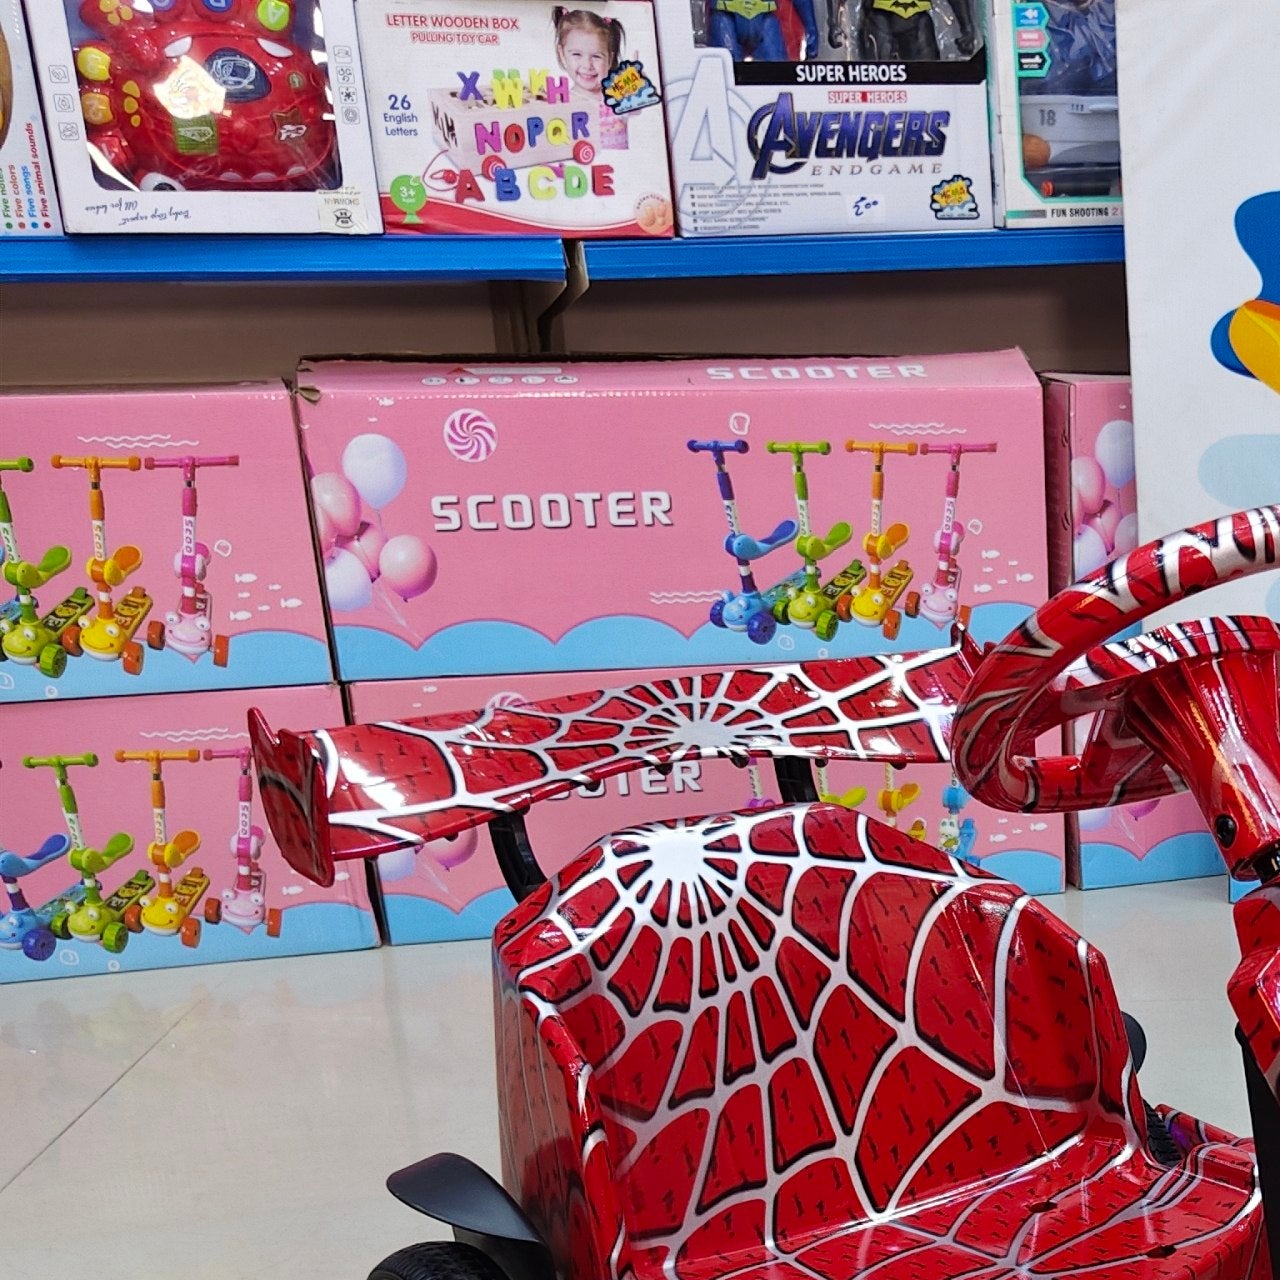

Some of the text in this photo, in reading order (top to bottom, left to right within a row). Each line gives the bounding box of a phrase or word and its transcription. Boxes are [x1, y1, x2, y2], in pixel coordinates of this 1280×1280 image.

[386, 14, 520, 30] LETTER WOODEN BOX
[411, 31, 498, 45] PULLING TOY CAR
[796, 65, 907, 83] SUPER HEROES
[387, 94, 412, 111] 26
[828, 91, 907, 104] SUPER HEROES
[383, 112, 418, 125] English
[1039, 109, 1056, 126] 18
[385, 126, 418, 137] Letters
[747, 92, 951, 181] AVENGERS
[24, 122, 49, 218] Five animal sounds
[811, 163, 943, 177] ENDGAME
[8, 164, 24, 218] Five colors
[21, 165, 37, 218] Five songs
[1, 199, 12, 218] Five
[1051, 209, 1067, 218] FUN
[1069, 207, 1109, 217] SHOOTING
[707, 361, 927, 383] SCOOTER
[430, 488, 674, 535] SCOOTER
